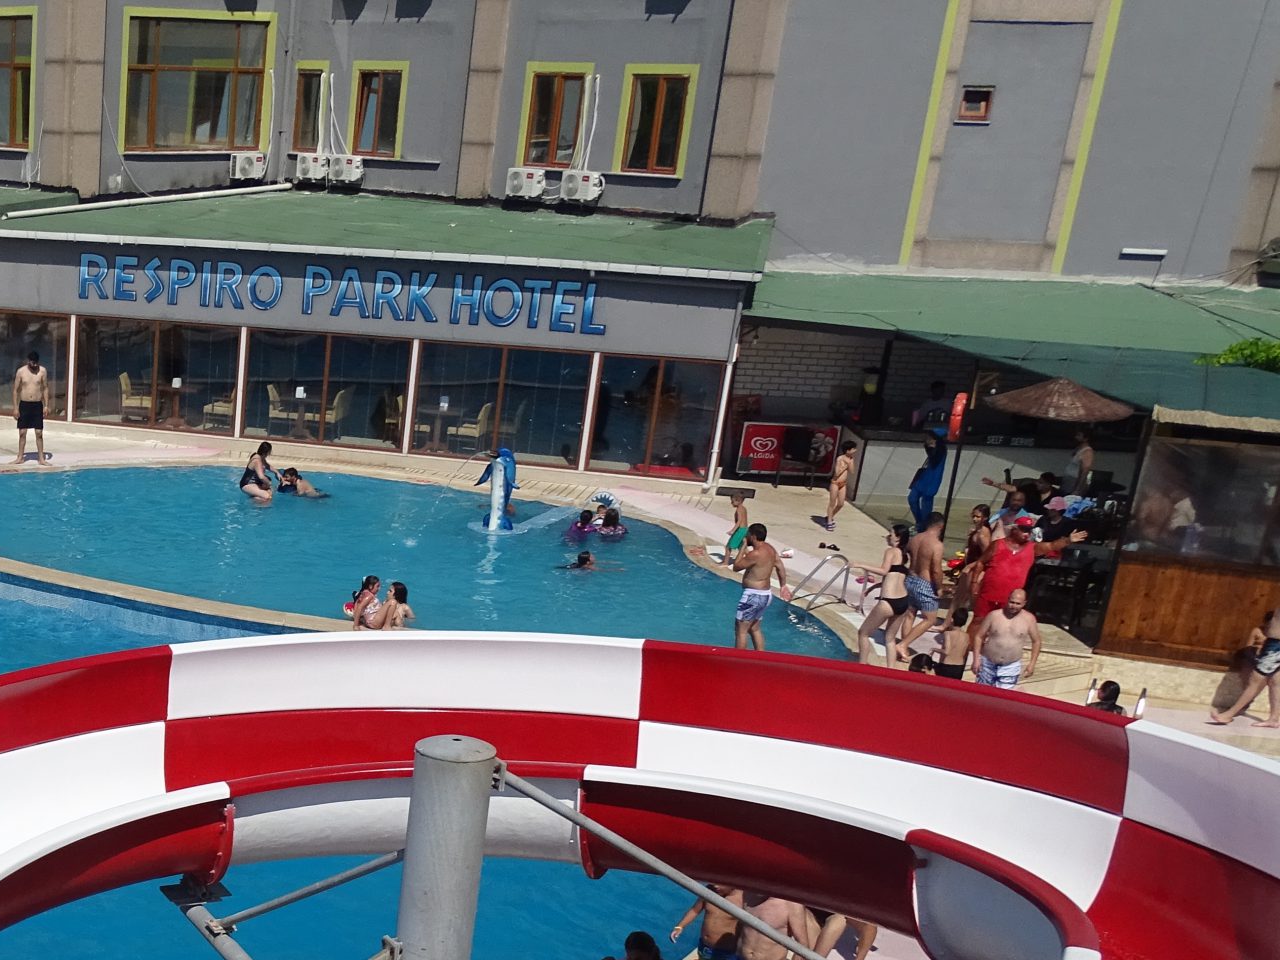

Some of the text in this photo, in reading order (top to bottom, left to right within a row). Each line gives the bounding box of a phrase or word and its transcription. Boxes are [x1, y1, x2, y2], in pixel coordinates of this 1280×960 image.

[78, 253, 607, 336] RESPIRO PARK HOTEL
[748, 451, 775, 460] ALGIDA
